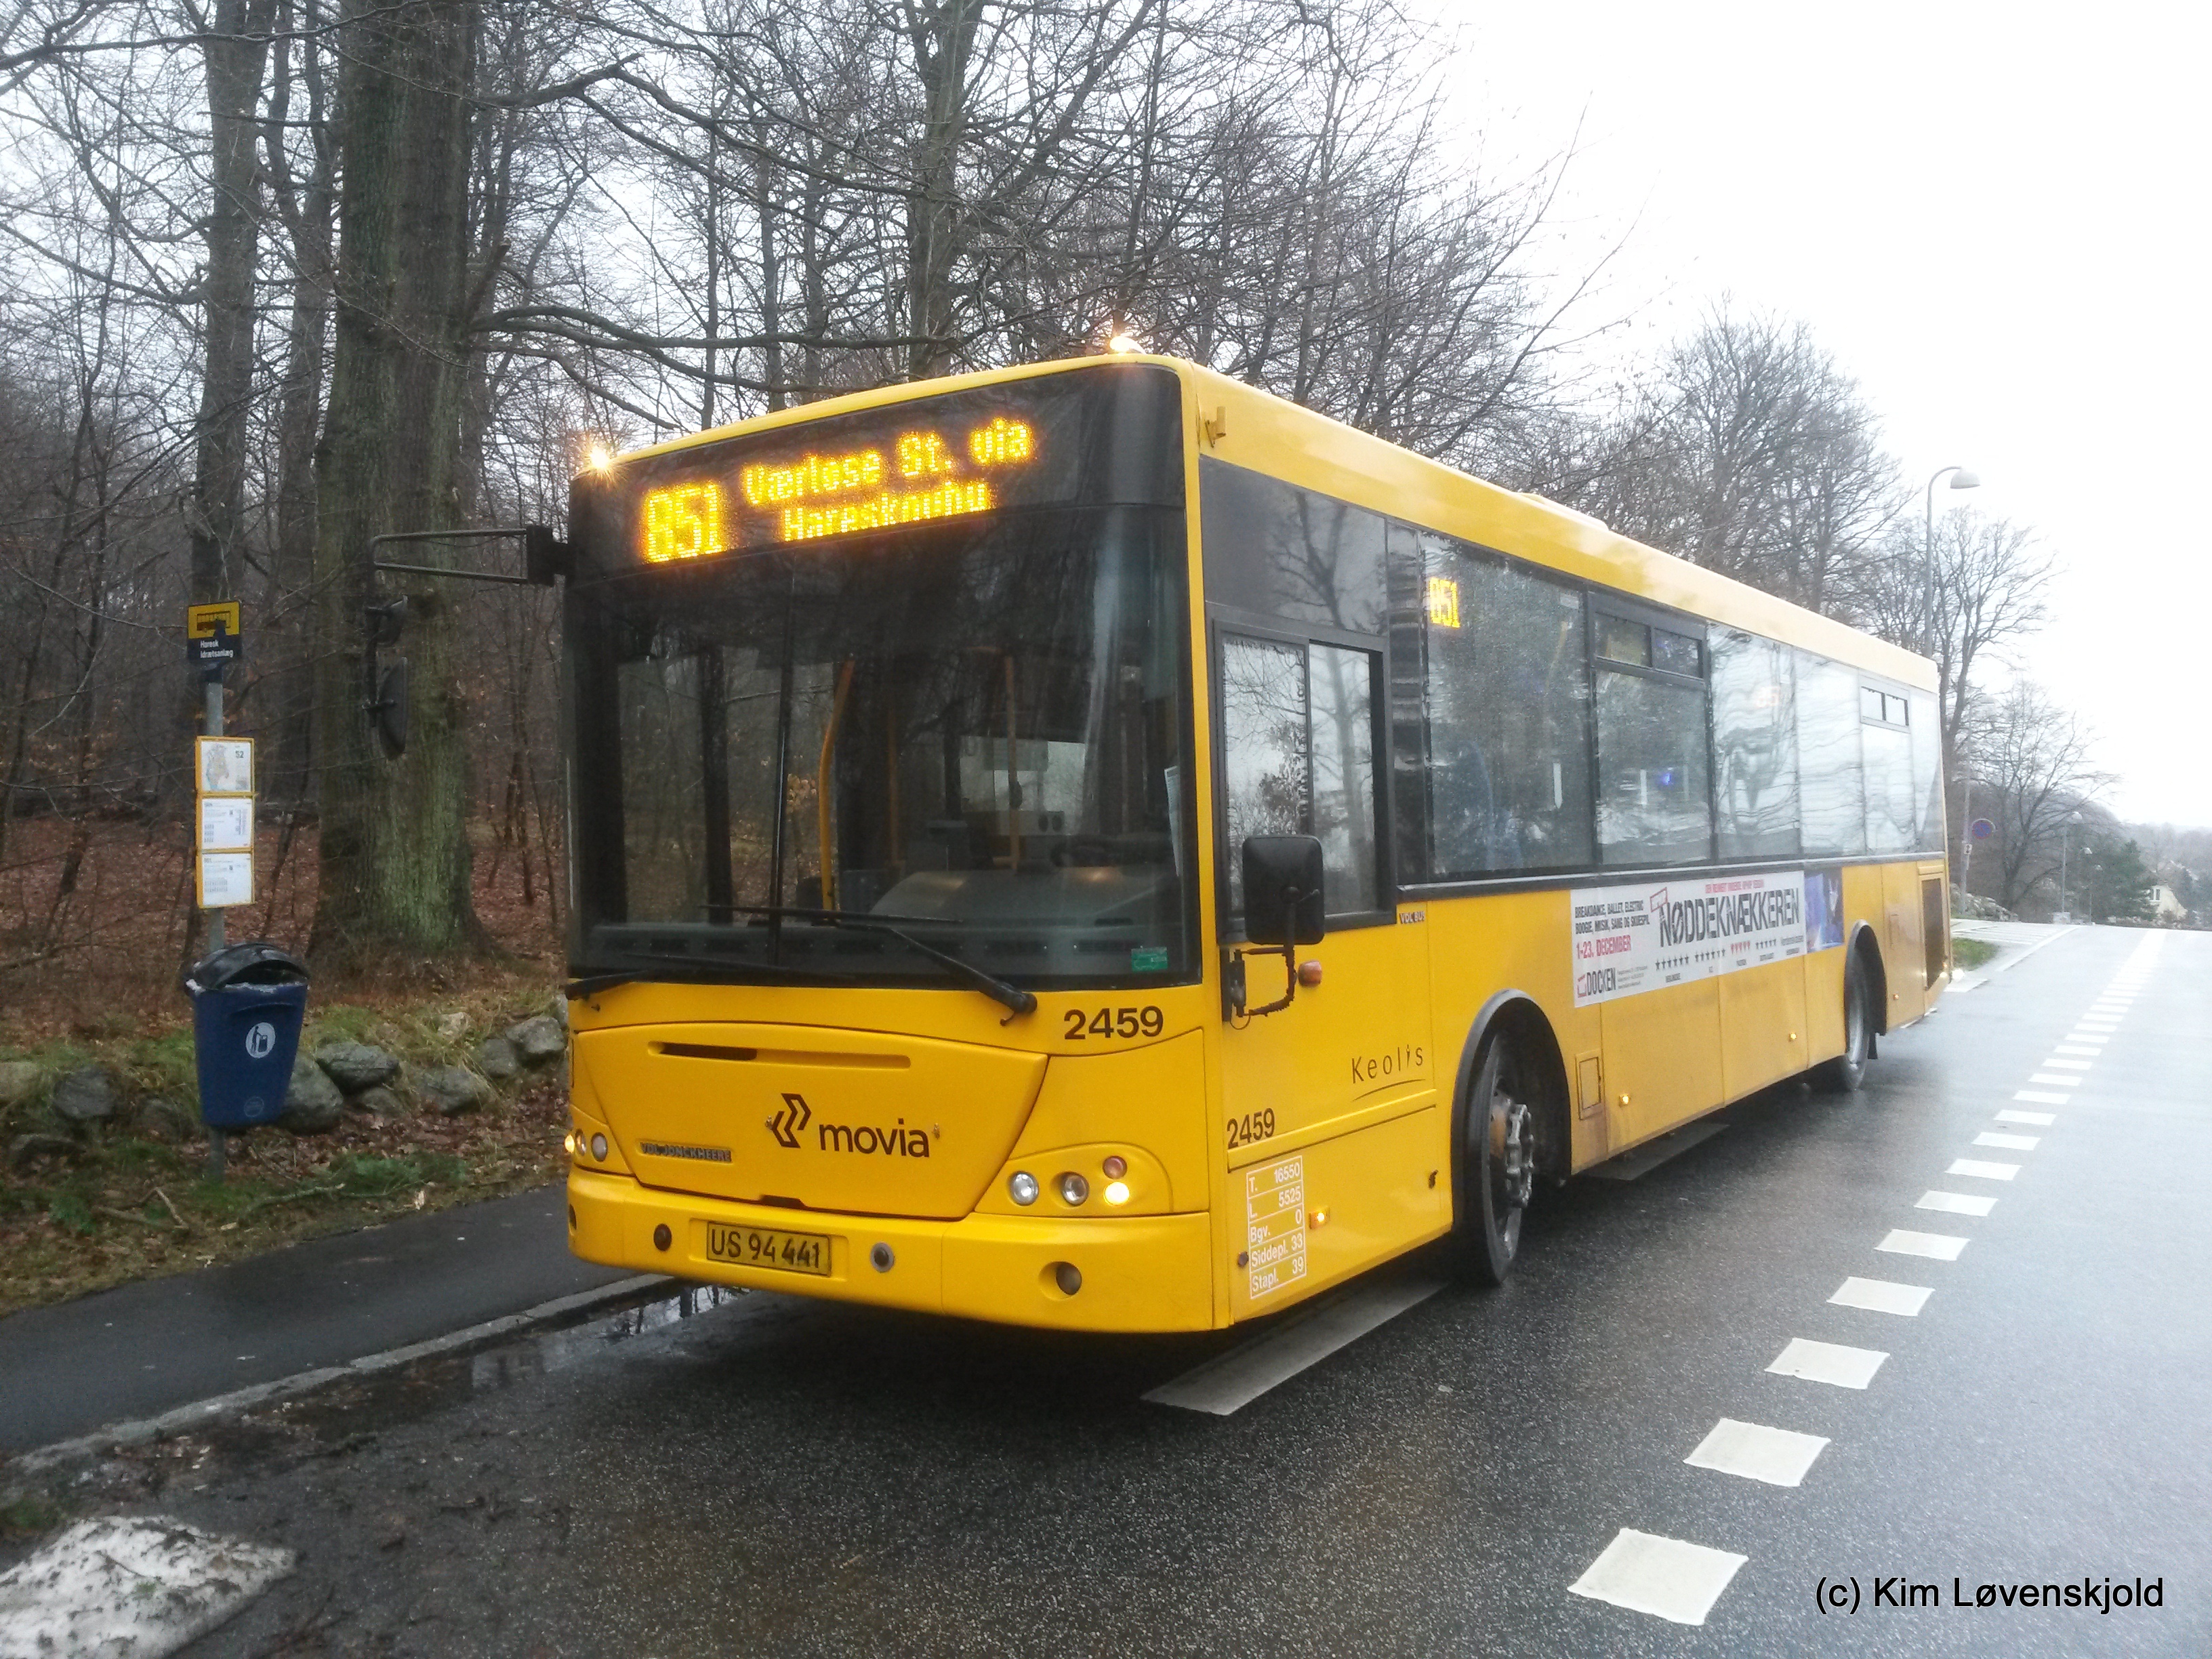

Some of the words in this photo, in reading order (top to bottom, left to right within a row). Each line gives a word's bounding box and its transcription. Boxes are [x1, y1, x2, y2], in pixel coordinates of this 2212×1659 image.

[900, 433, 952, 476] St.
[972, 419, 1029, 464] via
[647, 483, 723, 563] 851
[1660, 888, 1799, 947] NØDDEKNÆKKEREN
[1576, 941, 1594, 959] 1-23.
[1596, 935, 1631, 956] DECEMBER
[1586, 967, 1616, 996] DOCKEN
[1064, 1006, 1164, 1040] 2459
[1351, 1044, 1424, 1084] Keolis
[819, 1118, 930, 1158] movia
[1227, 1108, 1275, 1149] 2459
[664, 1144, 731, 1162] JONCKHEERE
[1249, 1176, 1258, 1193] T.
[1273, 1162, 1300, 1184] 16550
[1249, 1203, 1258, 1218] L.
[1278, 1186, 1301, 1208] 5525
[1250, 1225, 1271, 1244] Bgv.
[1295, 1208, 1302, 1225] 0
[711, 1229, 741, 1258] US
[748, 1233, 775, 1263] 94
[781, 1237, 819, 1269] 441
[1251, 1240, 1288, 1267] Siddepl.
[1291, 1233, 1303, 1252] 33
[1252, 1269, 1279, 1292] Stapl.
[1292, 1256, 1304, 1275] 39
